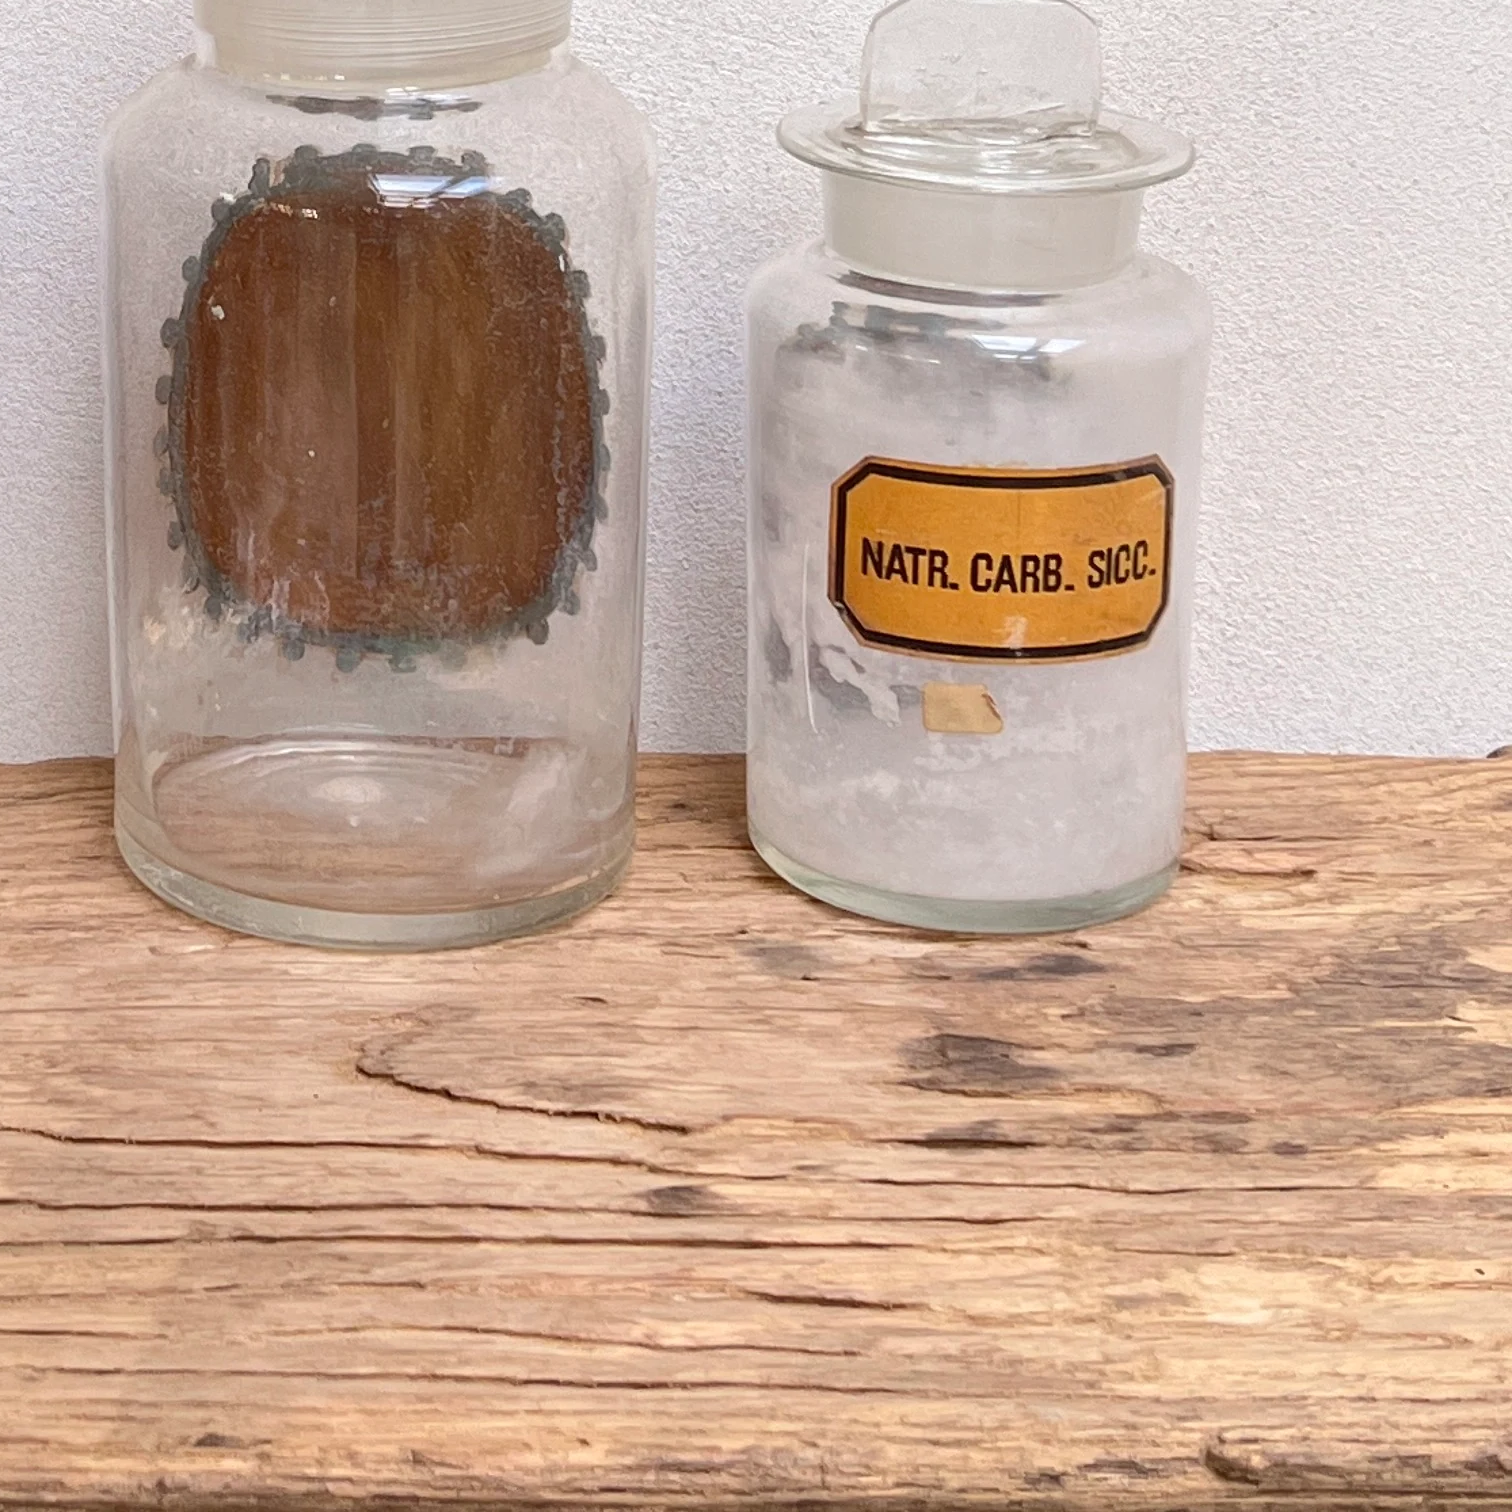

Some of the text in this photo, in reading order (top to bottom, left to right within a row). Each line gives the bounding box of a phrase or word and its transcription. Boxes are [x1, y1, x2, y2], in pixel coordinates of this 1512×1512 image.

[861, 536, 1156, 594] NATR. CARB. SICC.
